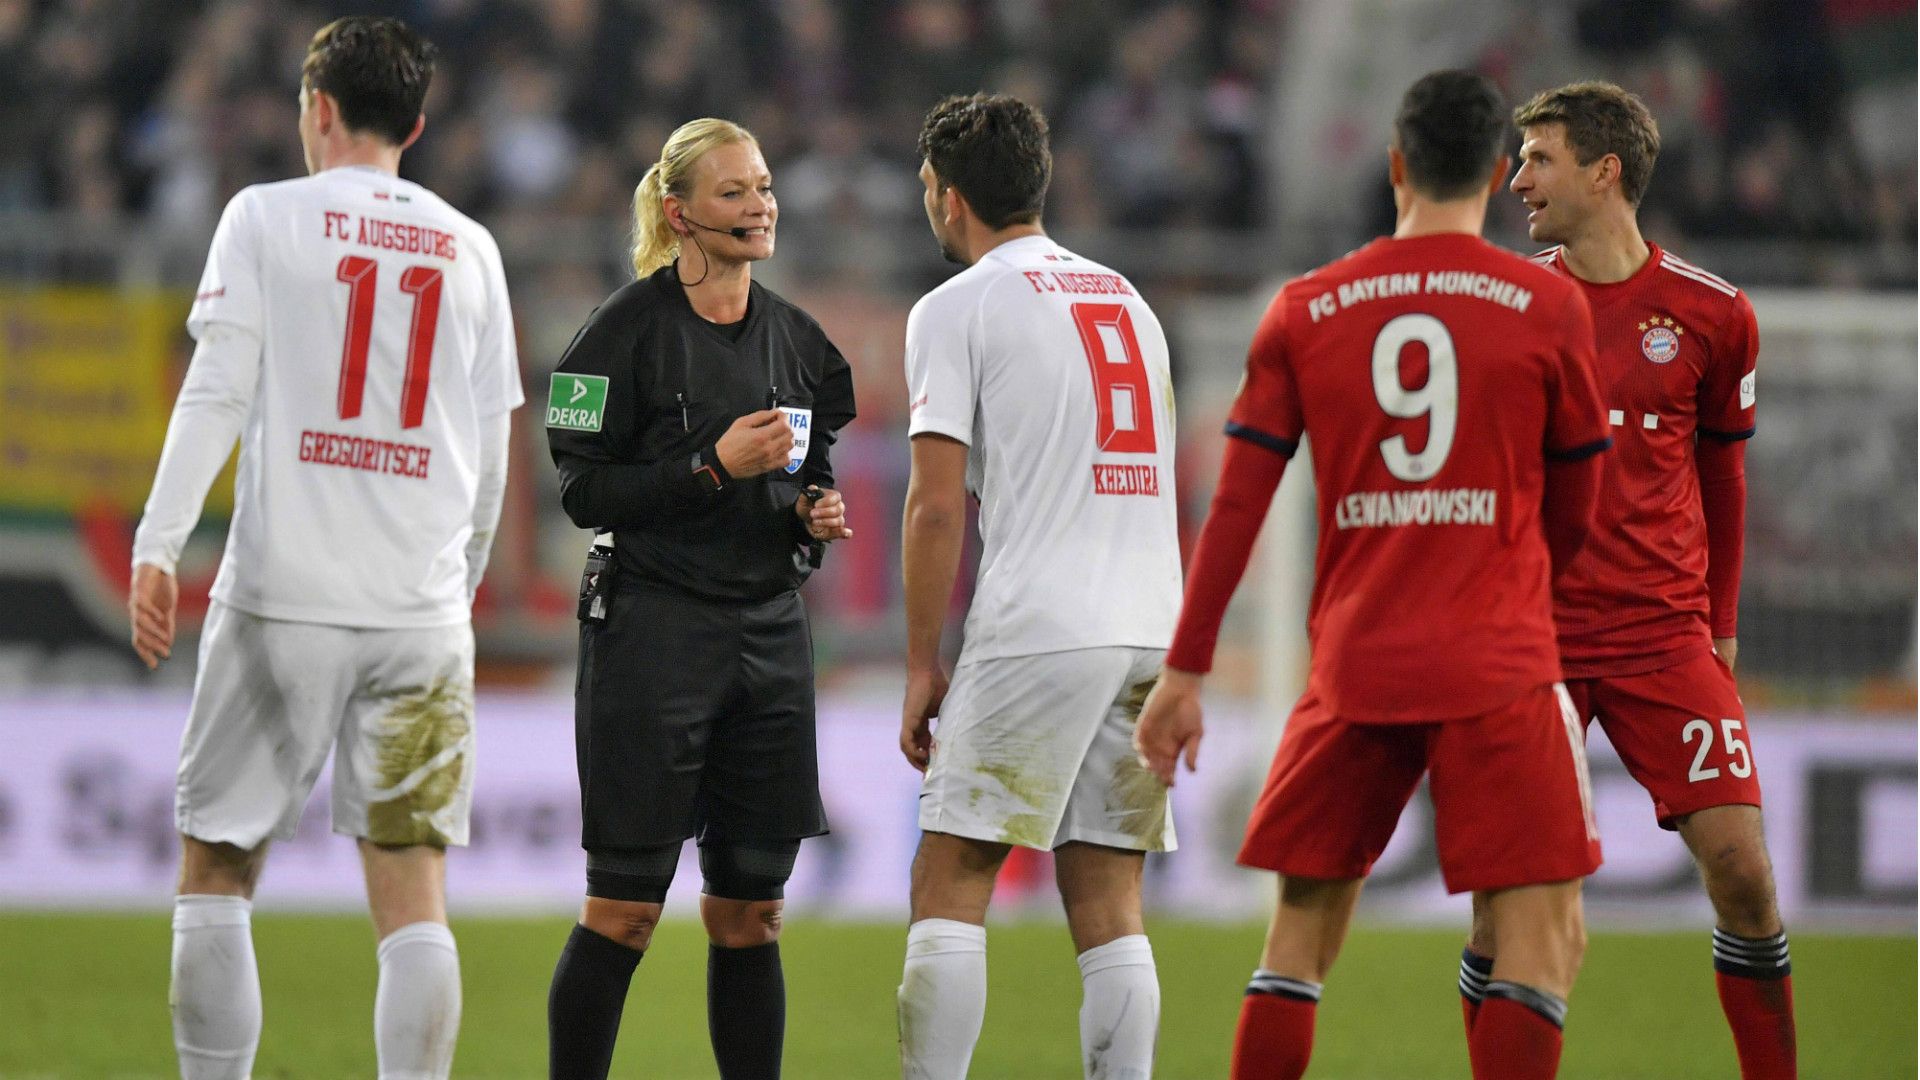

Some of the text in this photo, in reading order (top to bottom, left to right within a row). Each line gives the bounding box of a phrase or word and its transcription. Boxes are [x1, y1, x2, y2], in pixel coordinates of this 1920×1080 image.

[324, 211, 456, 260] FC AUGSBURG
[1023, 271, 1055, 293] FC
[1308, 271, 1532, 323] FC BAYERN MÜNCHEN
[337, 255, 443, 429] 11
[1070, 302, 1157, 453] 8
[1371, 312, 1460, 483] 9
[548, 406, 599, 429] DEKRA
[788, 413, 807, 428] IFA
[299, 430, 432, 480] GREGORITSCH
[1092, 463, 1160, 497] KHEDIRA
[1336, 489, 1496, 529] LEWANDOWSKI
[1682, 718, 1752, 783] 25
